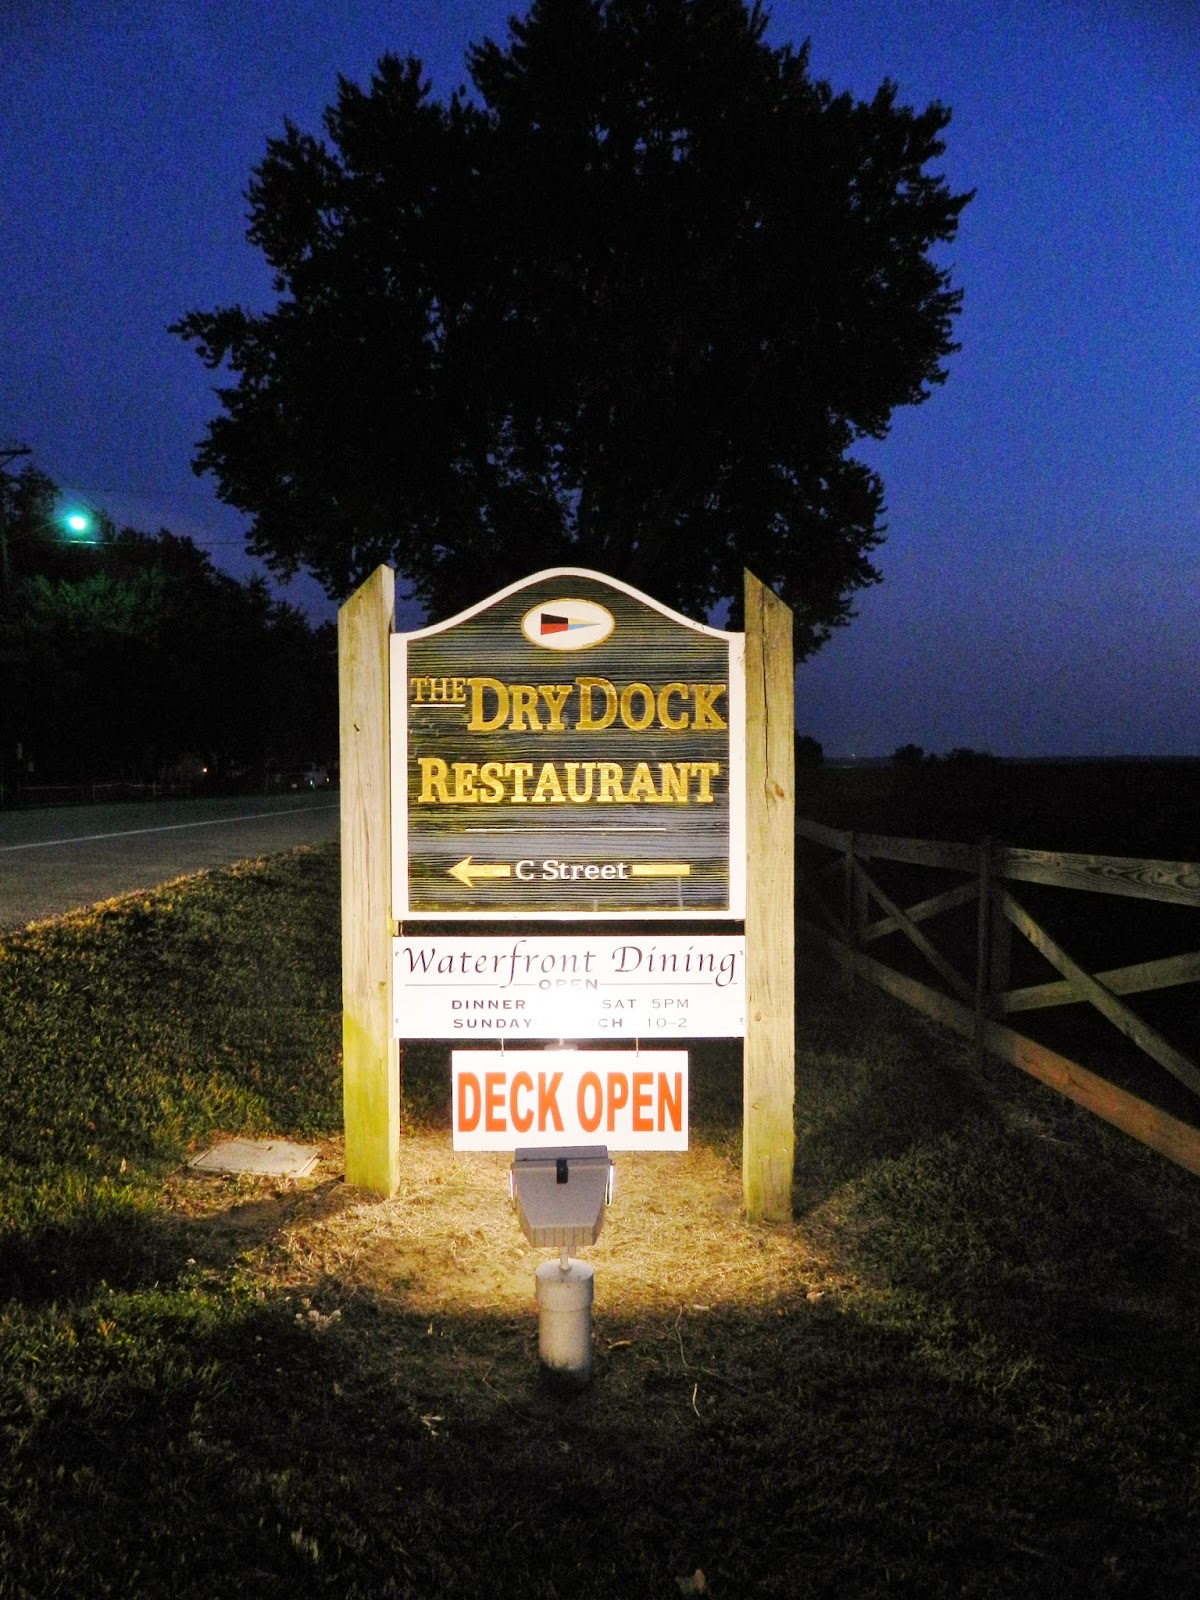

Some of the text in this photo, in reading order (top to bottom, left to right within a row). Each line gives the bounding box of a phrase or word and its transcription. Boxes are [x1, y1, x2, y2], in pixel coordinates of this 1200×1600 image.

[411, 677, 467, 701] THE
[417, 757, 719, 803] RESTAURANT
[515, 859, 628, 881] C Street
[403, 940, 737, 989] Waterfront Dining
[538, 978, 599, 991] OPEN
[451, 998, 690, 1010] DINNER SAT 5PM
[453, 1017, 688, 1029] SUNDAY 10-2
[457, 1071, 682, 1132] DECK OPEN
